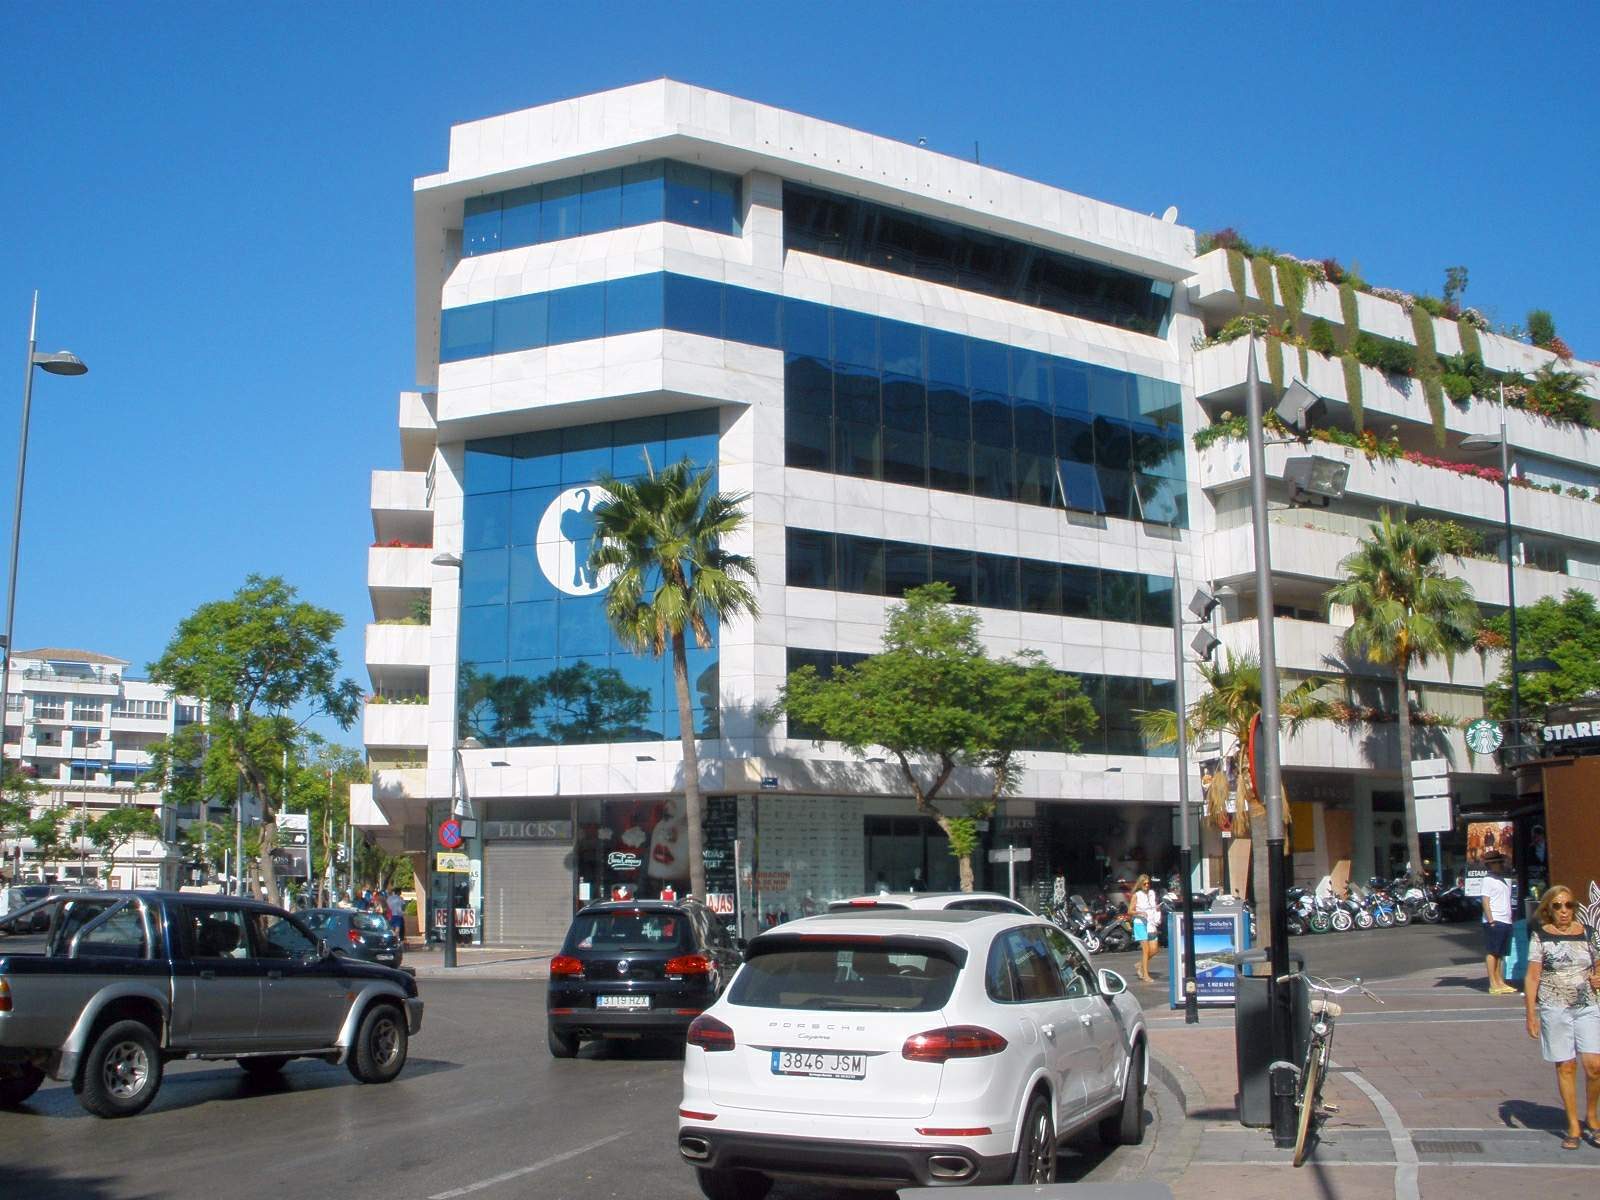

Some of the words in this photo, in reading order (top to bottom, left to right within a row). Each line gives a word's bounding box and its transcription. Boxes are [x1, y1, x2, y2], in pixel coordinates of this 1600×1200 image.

[499, 822, 556, 837] ELICES
[708, 895, 733, 912] AJAS
[436, 910, 475, 926] REAJAS
[769, 1022, 865, 1031] PORSCHE
[784, 1053, 823, 1070] 3846
[831, 1055, 861, 1072] JSM
